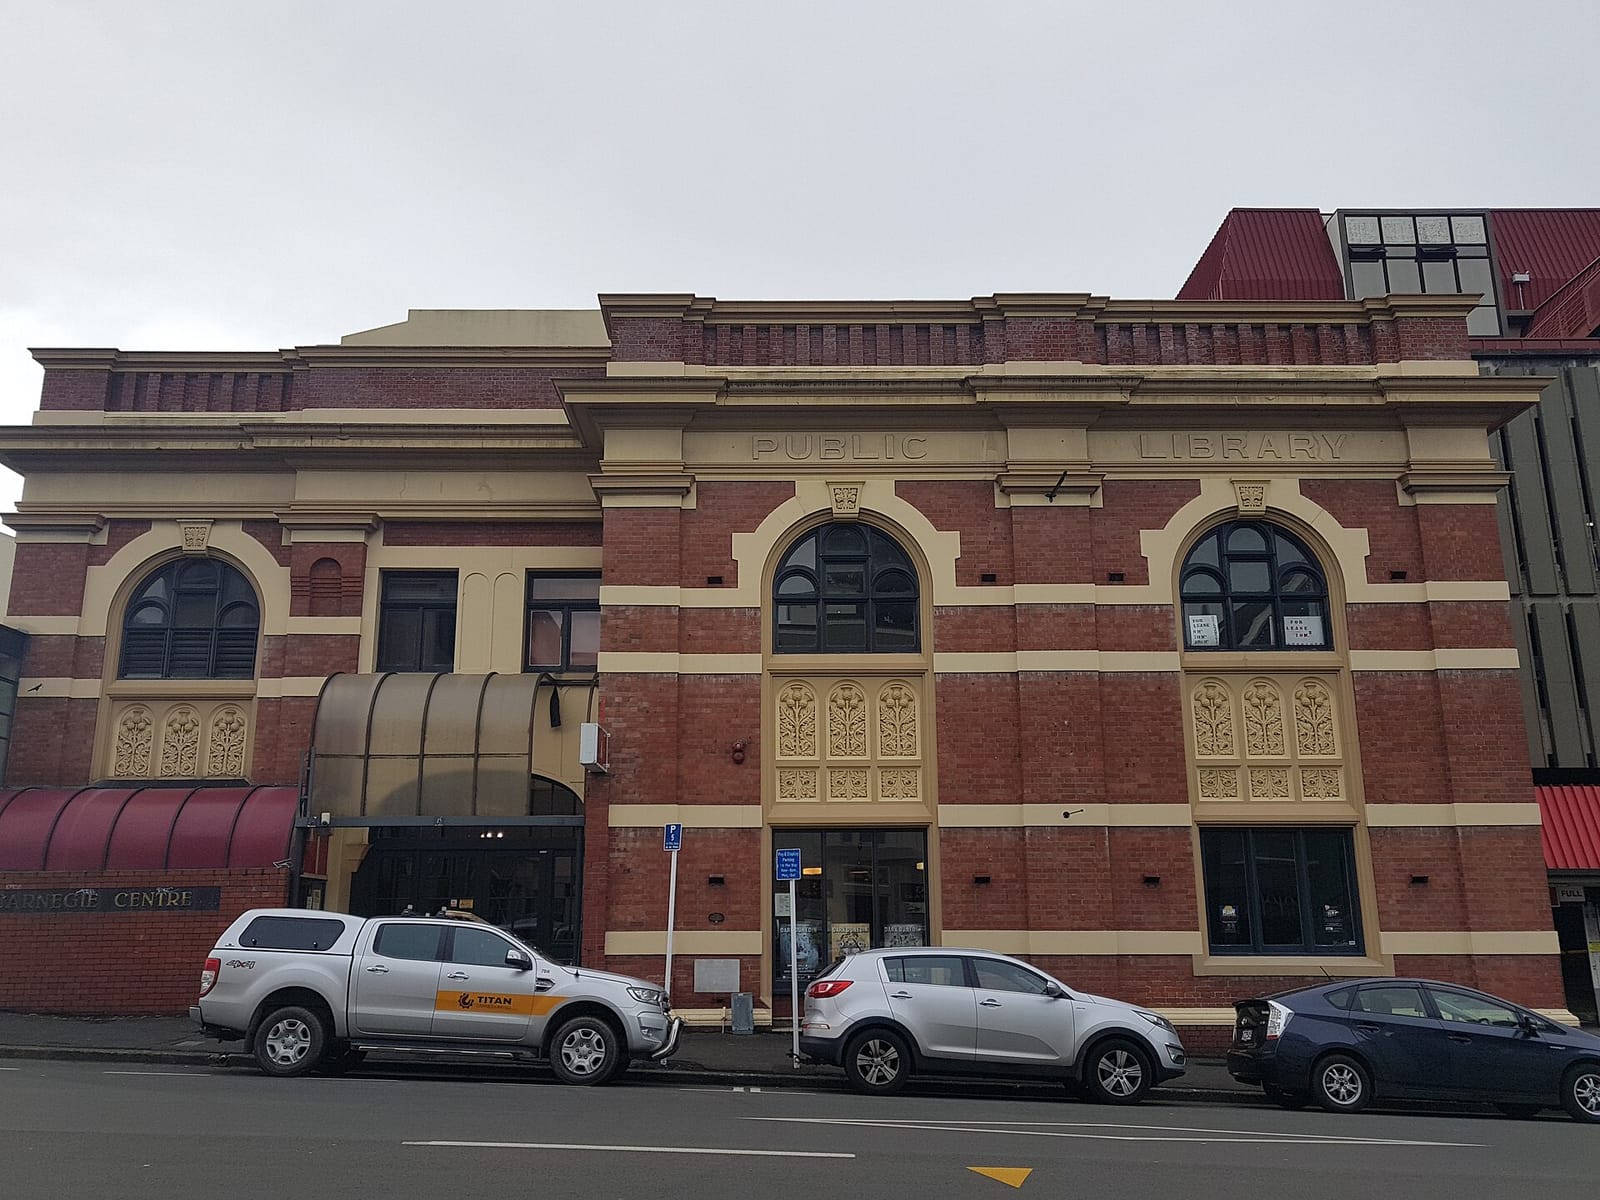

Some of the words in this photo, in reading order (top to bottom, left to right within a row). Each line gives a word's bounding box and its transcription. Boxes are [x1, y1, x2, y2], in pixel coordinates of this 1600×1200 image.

[752, 435, 927, 460] PUBLIC
[1139, 433, 1345, 460] LIBRARY
[670, 825, 677, 834] P
[1560, 889, 1583, 897] FULL
[114, 891, 193, 908] CENTRE
[477, 996, 512, 1005] TITAN
